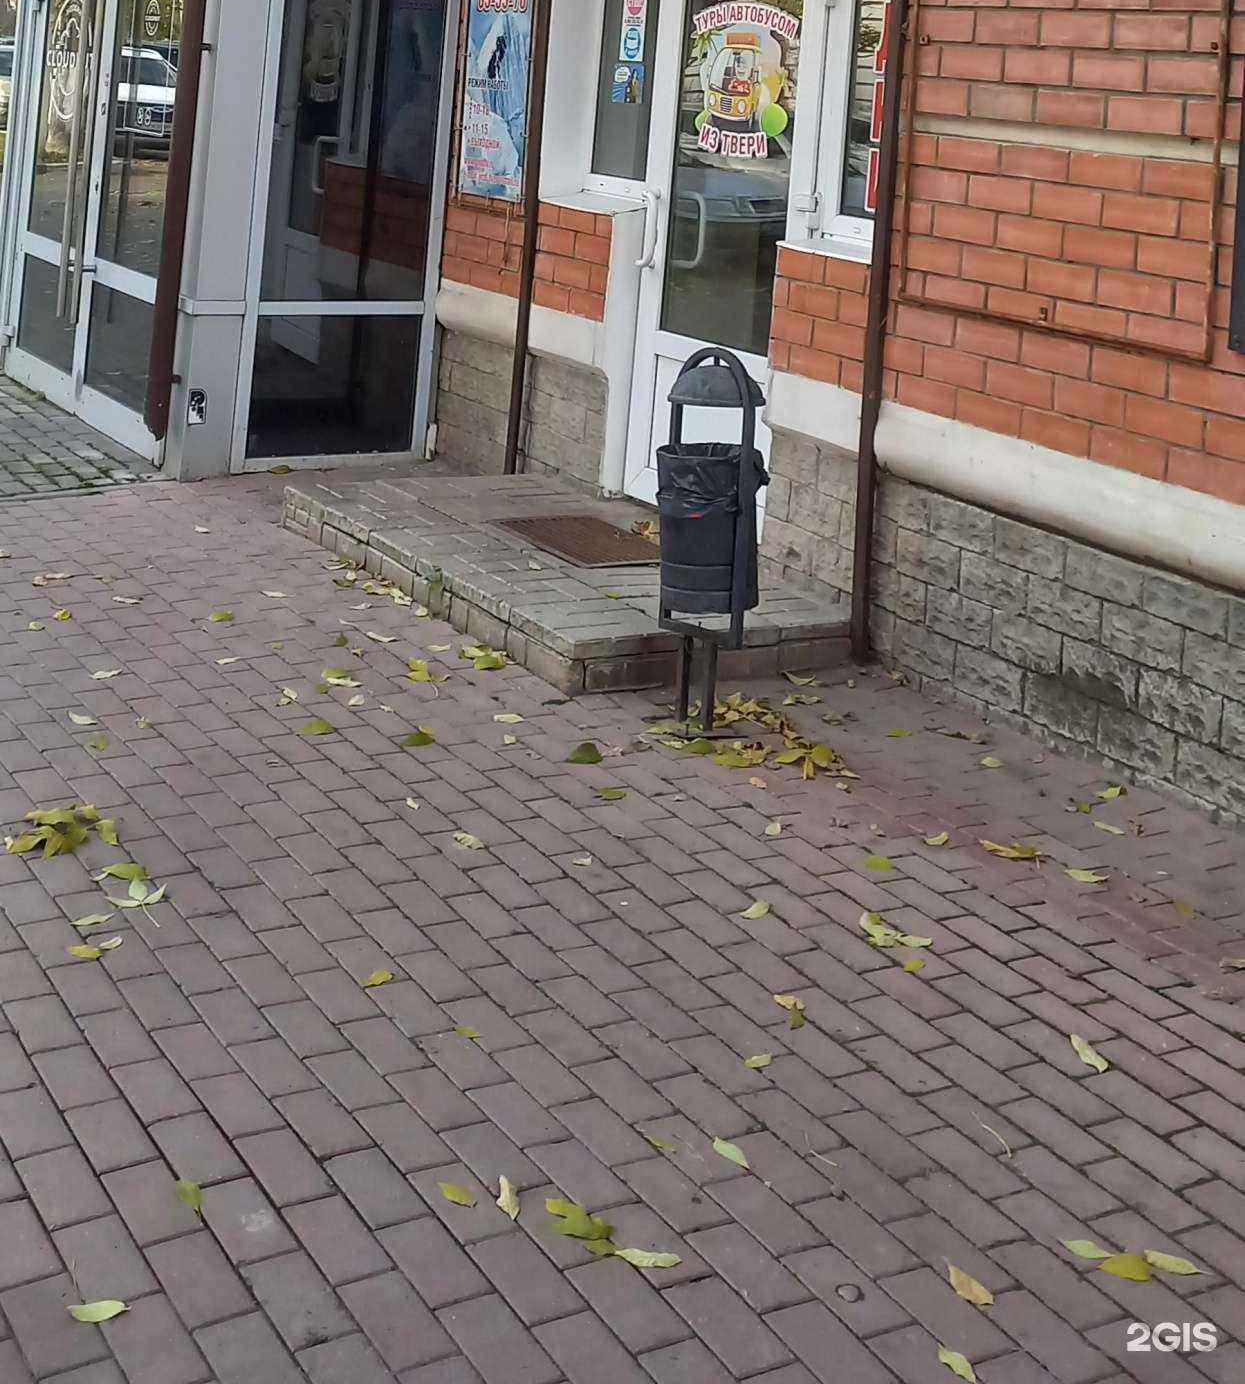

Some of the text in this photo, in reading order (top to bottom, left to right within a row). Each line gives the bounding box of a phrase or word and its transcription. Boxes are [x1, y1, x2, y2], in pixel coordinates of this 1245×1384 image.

[694, 5, 798, 37] ТУРЫ АВТОБУСОМ
[701, 127, 766, 155] ИЗ ТВЕРИ
